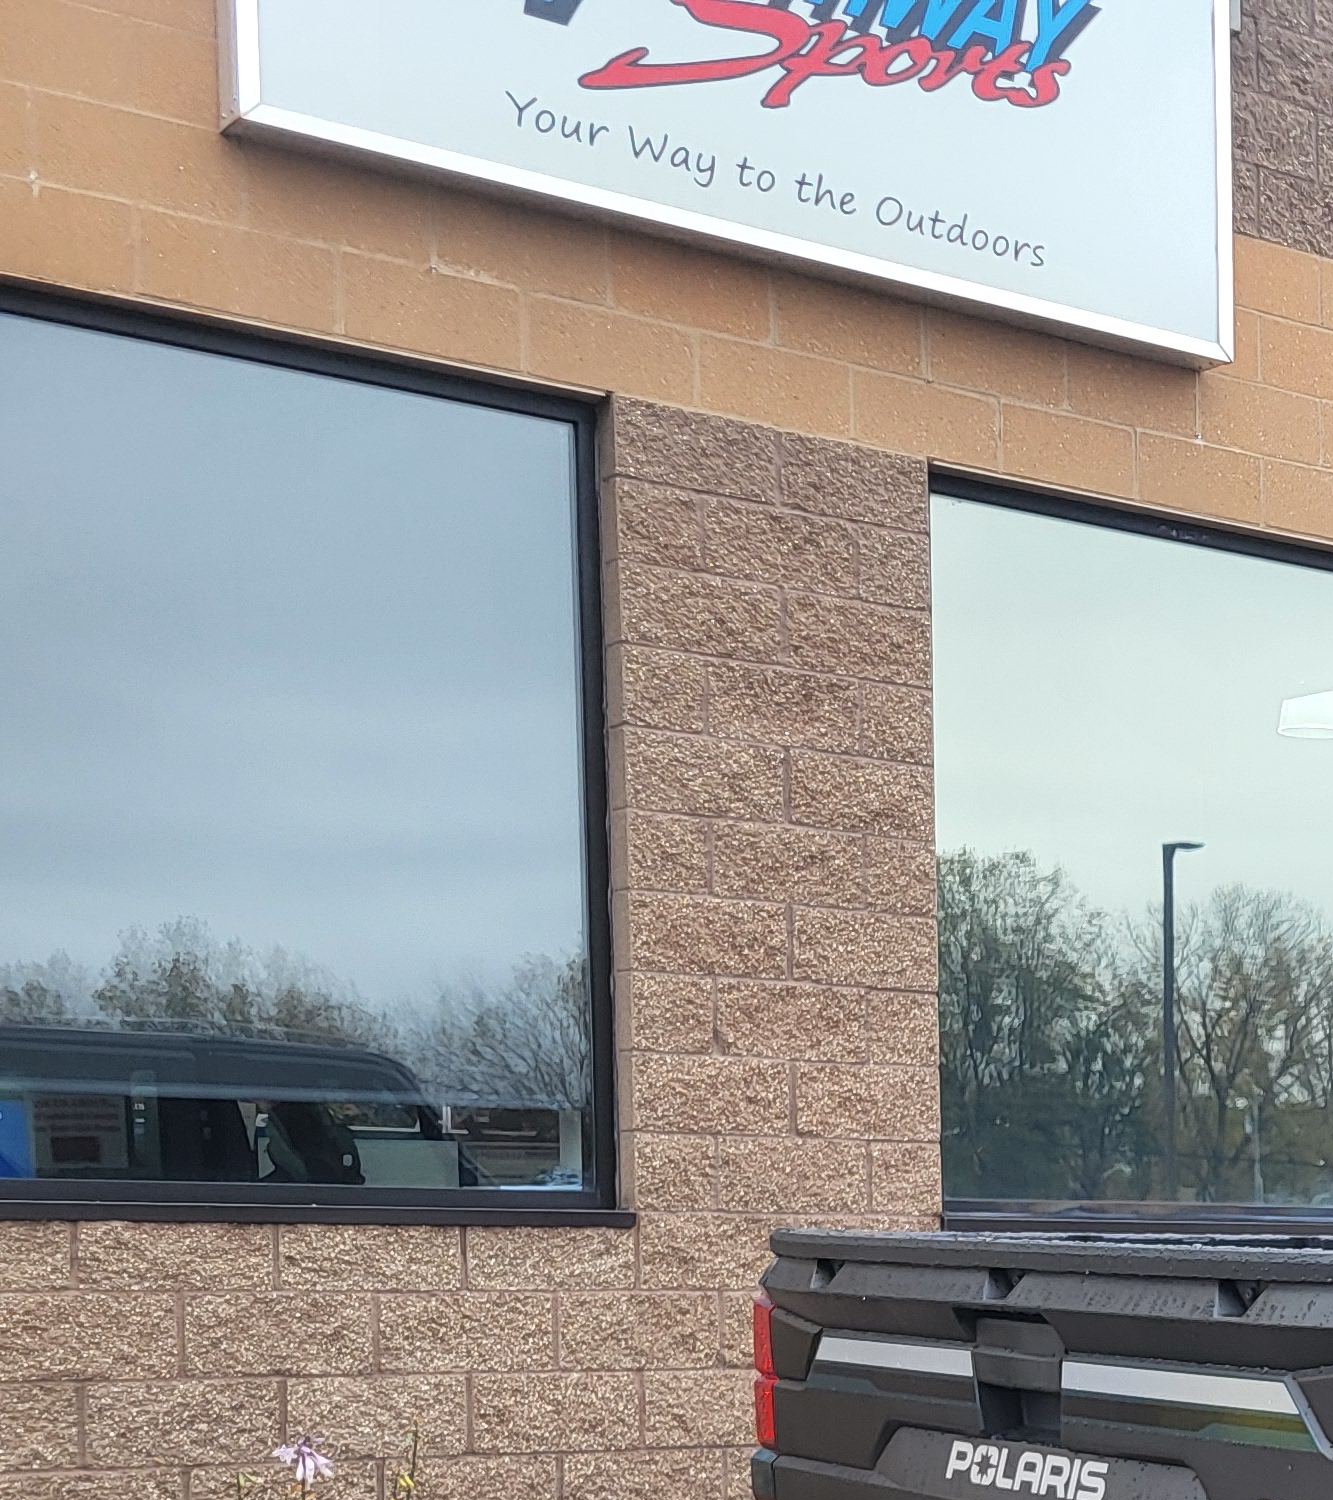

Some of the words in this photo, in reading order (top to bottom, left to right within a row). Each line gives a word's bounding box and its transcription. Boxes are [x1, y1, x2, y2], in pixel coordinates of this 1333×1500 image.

[577, 0, 1071, 108] Sports
[505, 90, 609, 147] Your
[627, 125, 717, 188] Way
[736, 156, 776, 192] to
[794, 172, 857, 215] the
[875, 196, 1045, 267] Outdoors
